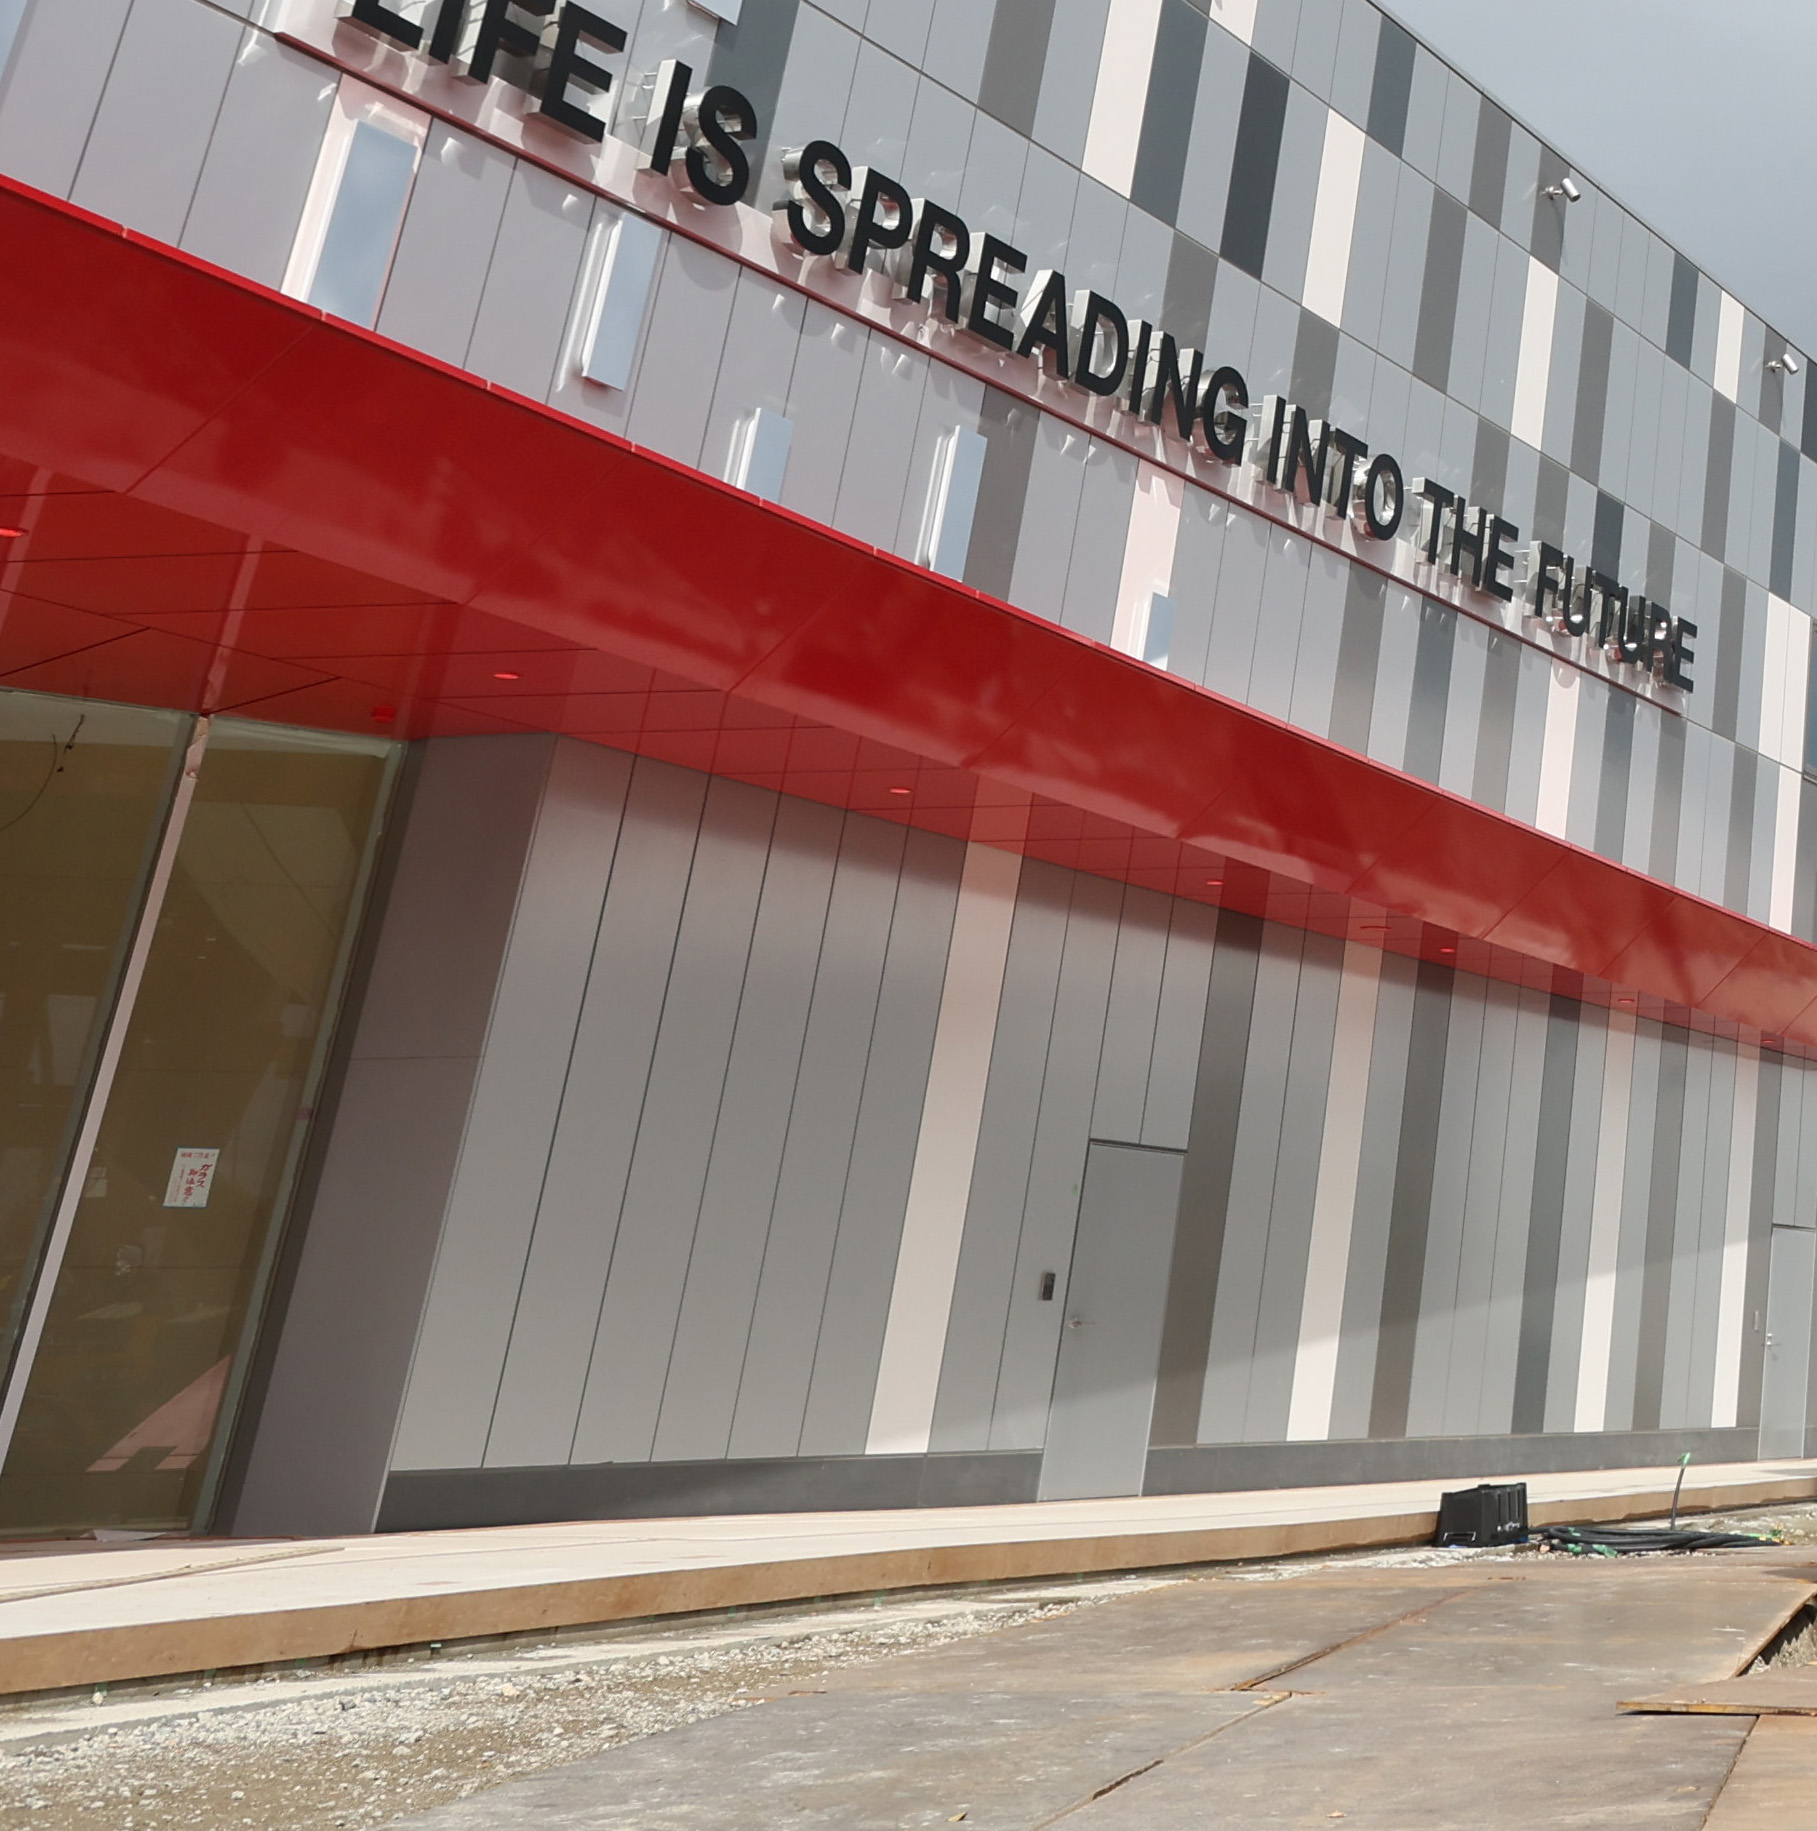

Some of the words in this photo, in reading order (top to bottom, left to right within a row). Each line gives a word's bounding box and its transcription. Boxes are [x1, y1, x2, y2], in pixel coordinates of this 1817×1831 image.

[641, 58, 758, 207] IS
[774, 139, 1249, 466] SPREADING
[1257, 396, 1405, 541] INTO
[1412, 477, 1520, 601] THE
[1529, 540, 1698, 694] FUTURE
